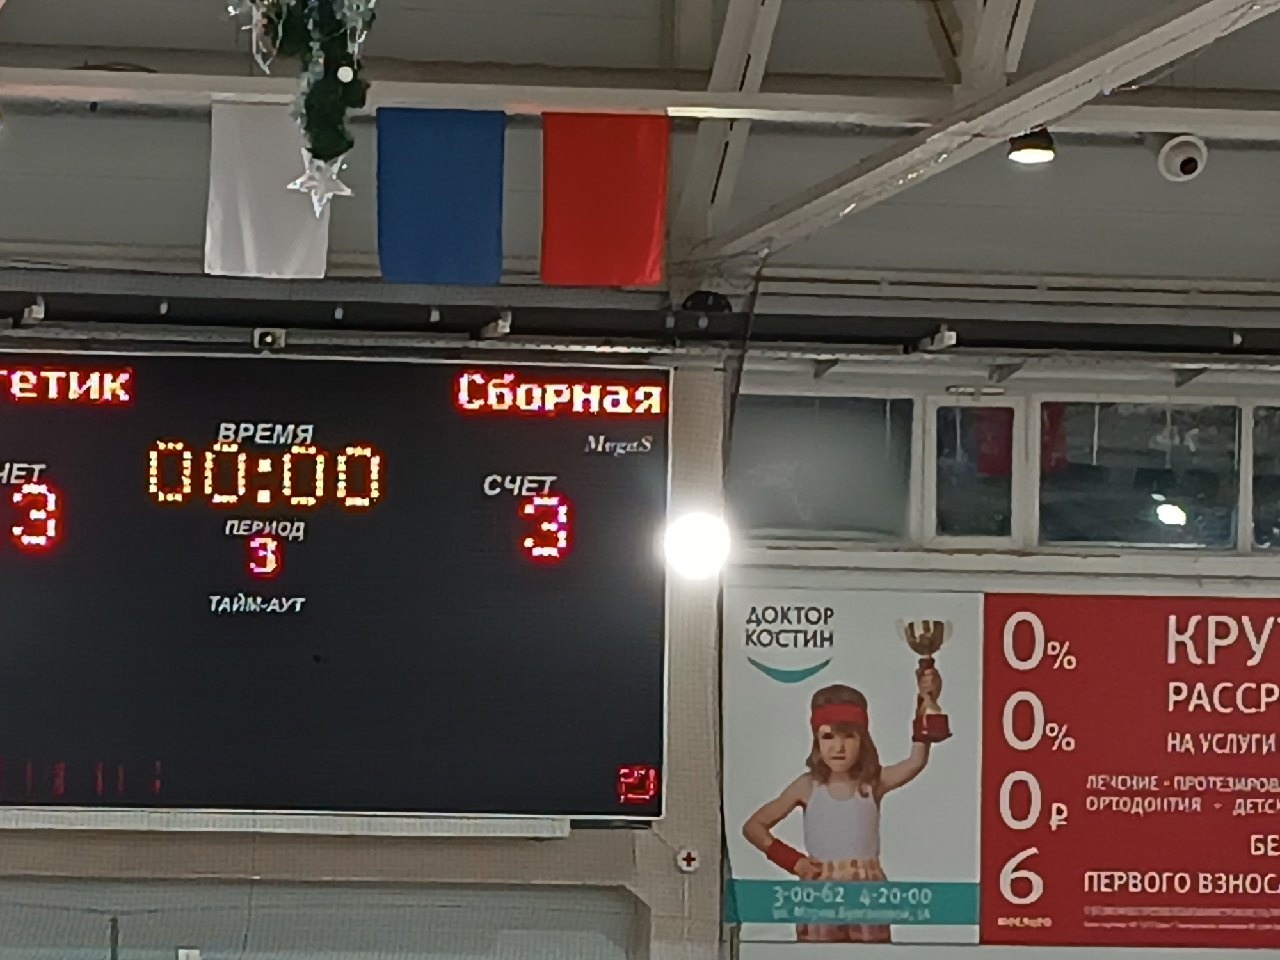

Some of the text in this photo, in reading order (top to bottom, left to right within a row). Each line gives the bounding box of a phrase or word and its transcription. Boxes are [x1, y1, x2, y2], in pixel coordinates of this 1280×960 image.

[458, 373, 662, 414] Сборная
[218, 423, 314, 445] ВРЕМЯ
[149, 440, 380, 507] 00:00
[483, 474, 557, 496] СЧЕТ
[225, 519, 305, 541] ПЕРИОД
[523, 496, 568, 557] 3
[249, 537, 278, 573] 3
[209, 593, 306, 614] ТАЙМ-АУТ
[746, 606, 834, 627] ДОКТОР
[745, 628, 834, 648] КОСТИН
[1167, 614, 1280, 666] КРУ
[1167, 732, 1276, 756] НА УСЛУГИ
[999, 846, 1044, 905] 6
[1084, 871, 1280, 894] ПЕРВОГО ВЗНОС
